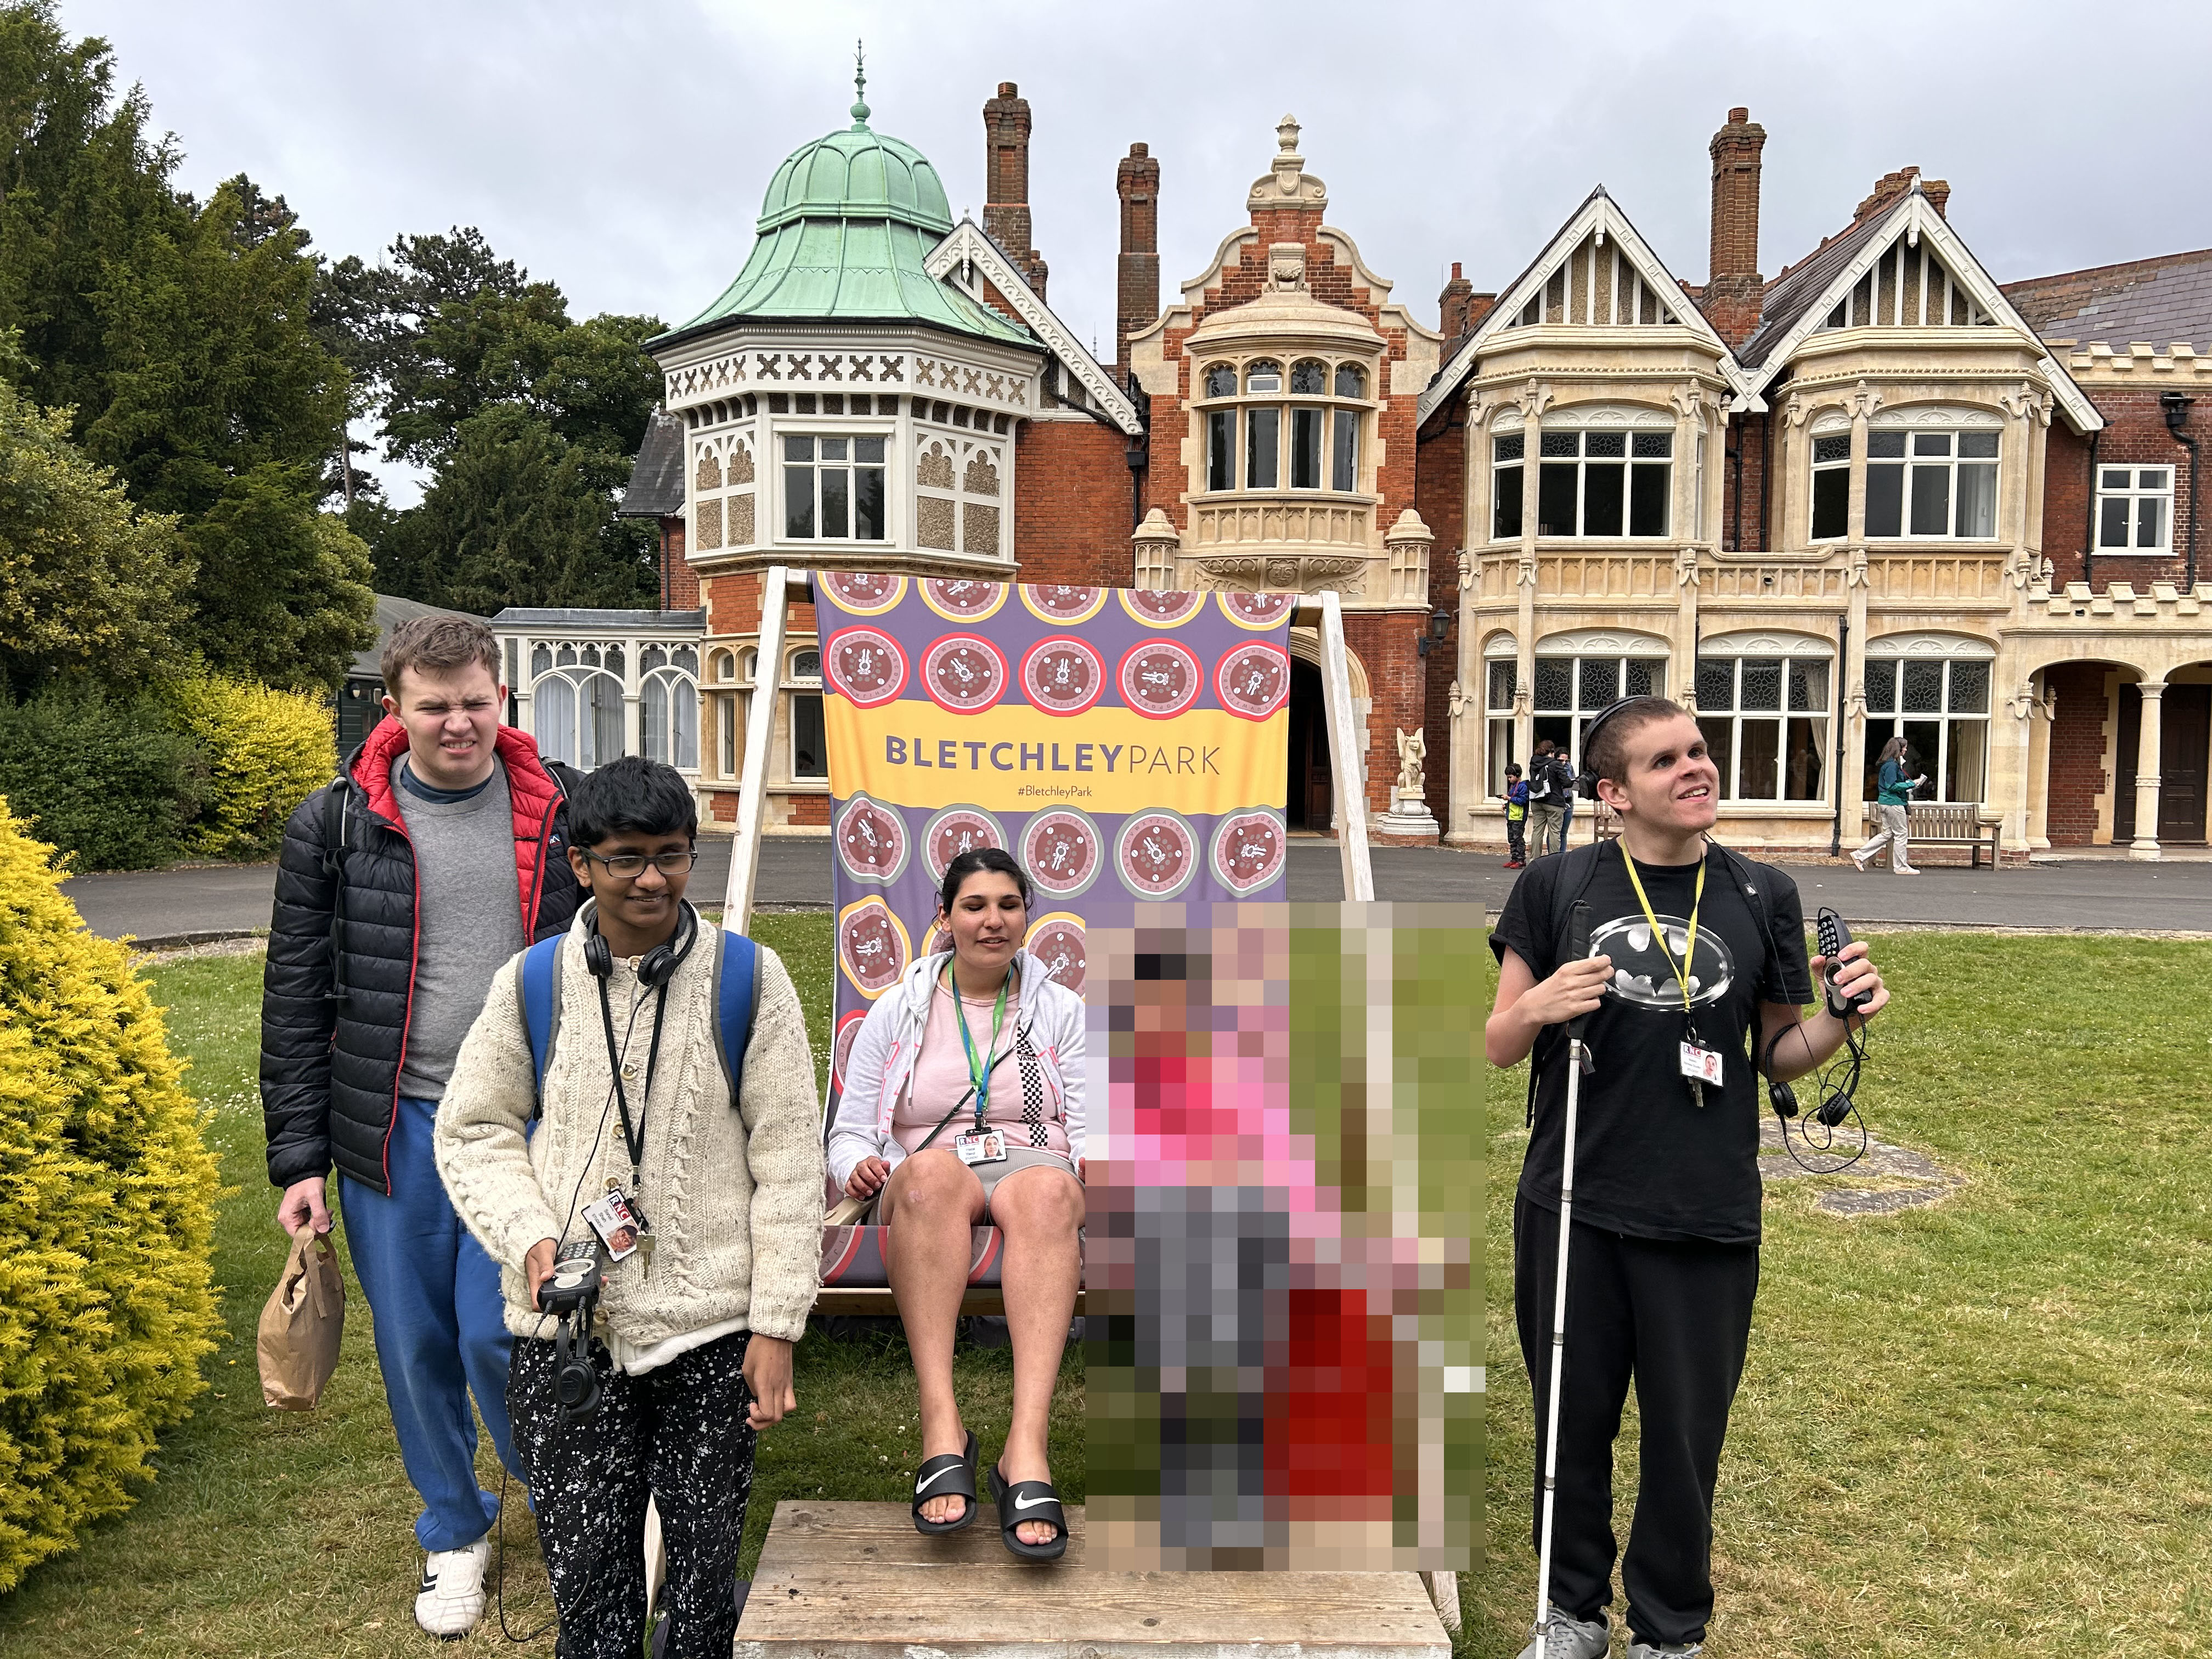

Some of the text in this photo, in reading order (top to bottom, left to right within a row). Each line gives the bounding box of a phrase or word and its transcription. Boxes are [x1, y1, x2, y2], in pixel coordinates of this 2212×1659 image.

[1018, 785, 1092, 799] #BletchleyPark
[1684, 1046, 1701, 1057] RNC
[960, 1136, 979, 1145] RNC
[610, 1195, 629, 1220] RNC
